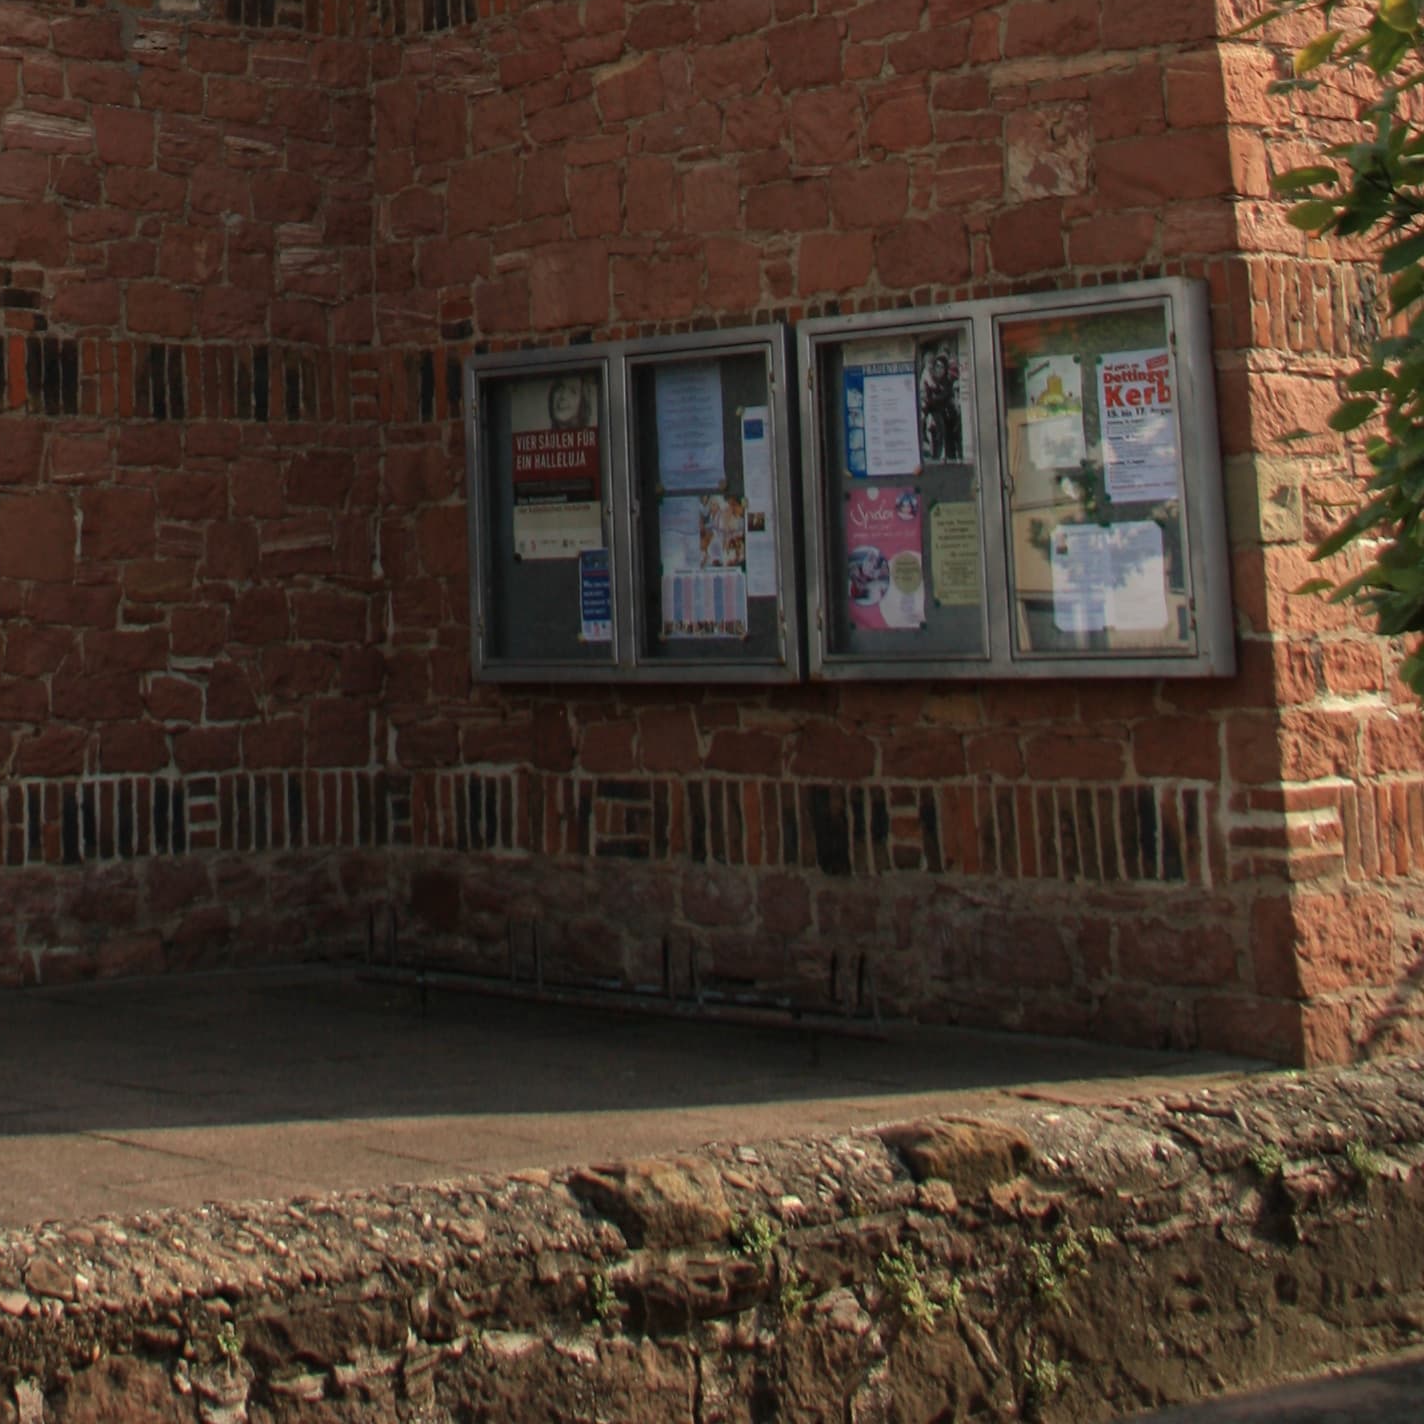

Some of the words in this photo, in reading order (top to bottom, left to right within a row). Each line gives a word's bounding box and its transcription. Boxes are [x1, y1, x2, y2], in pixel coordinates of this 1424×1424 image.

[1104, 376, 1171, 408] Kerb
[515, 434, 537, 451] VIER
[538, 431, 574, 449] SÄULEN
[577, 429, 596, 447] FÜR
[516, 455, 531, 471] EIN
[534, 451, 586, 470] HALLELUJA
